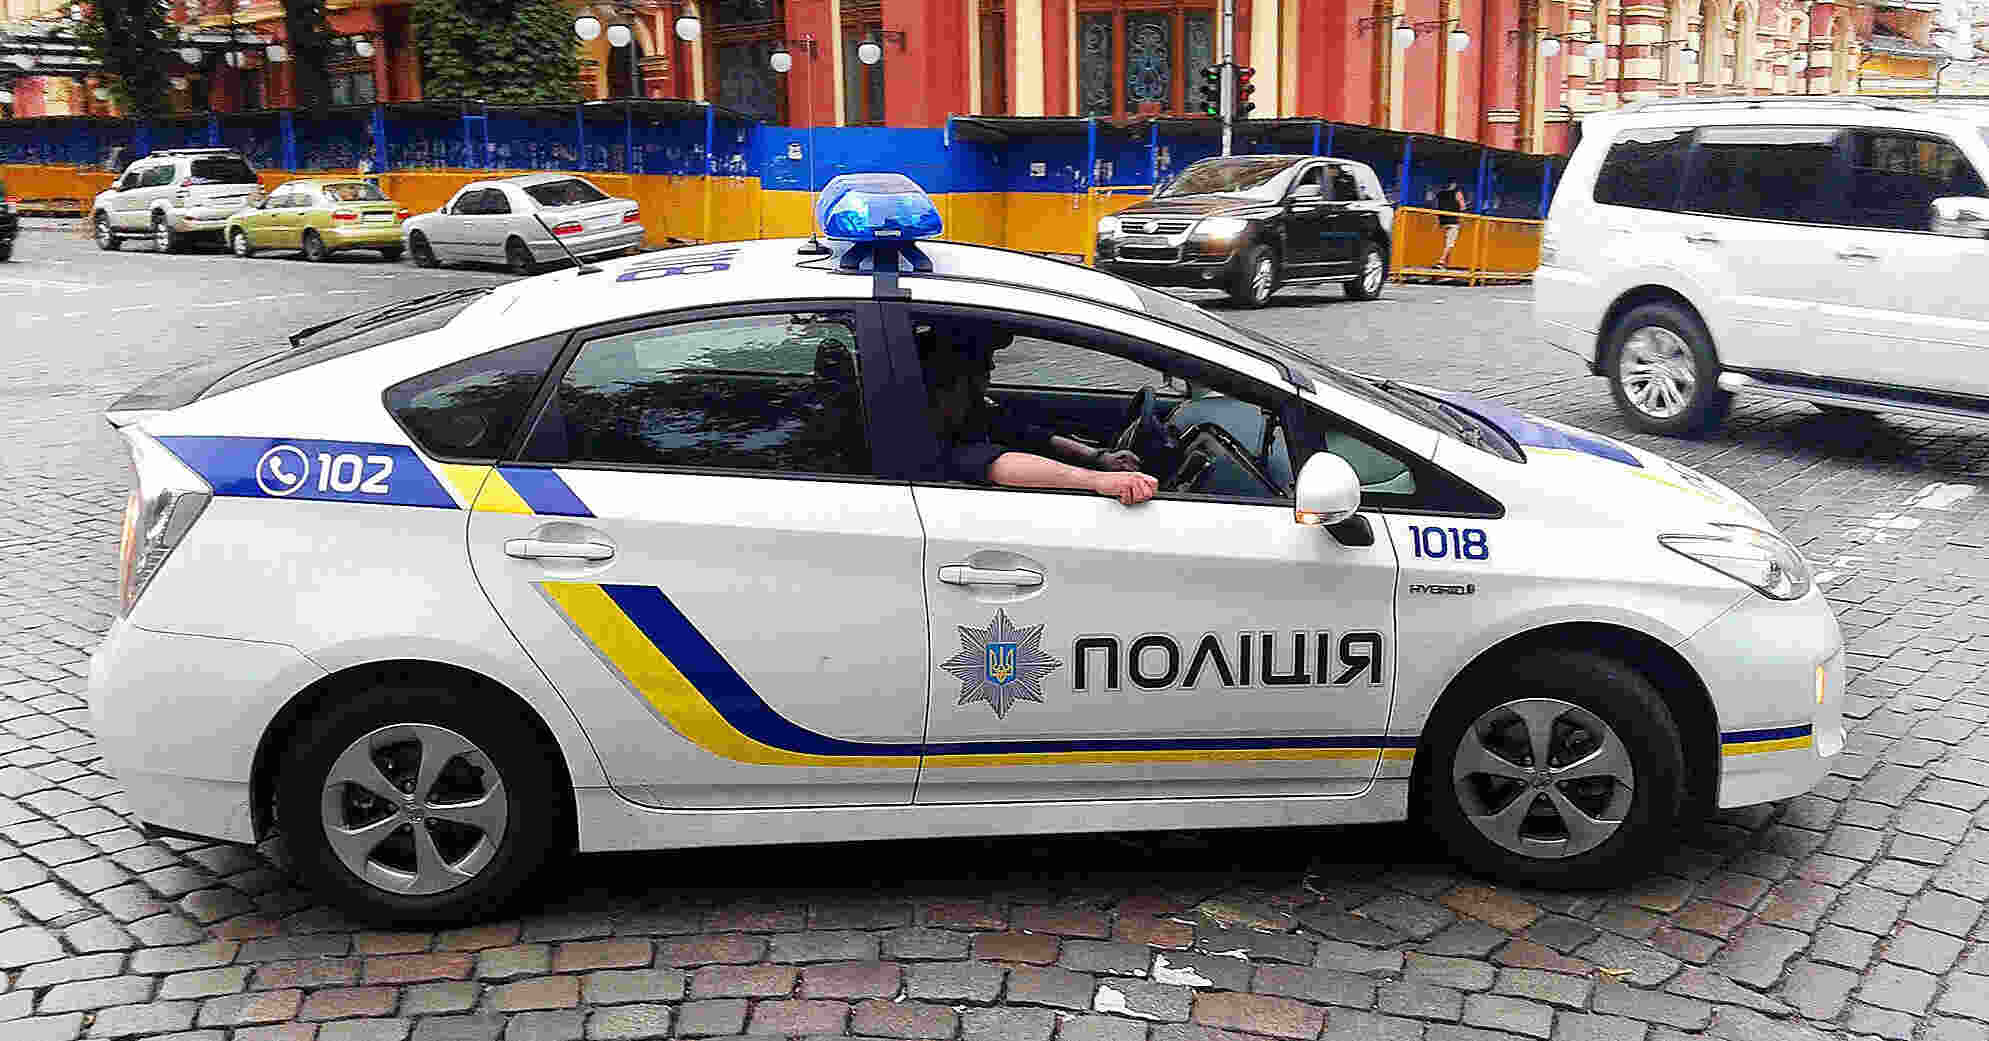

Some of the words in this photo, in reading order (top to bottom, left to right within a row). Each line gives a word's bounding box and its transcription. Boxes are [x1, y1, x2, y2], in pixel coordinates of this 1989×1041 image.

[318, 452, 393, 494] 102
[1408, 525, 1489, 561] 1018
[1073, 631, 1384, 691] ПОЛІЦІЯ
